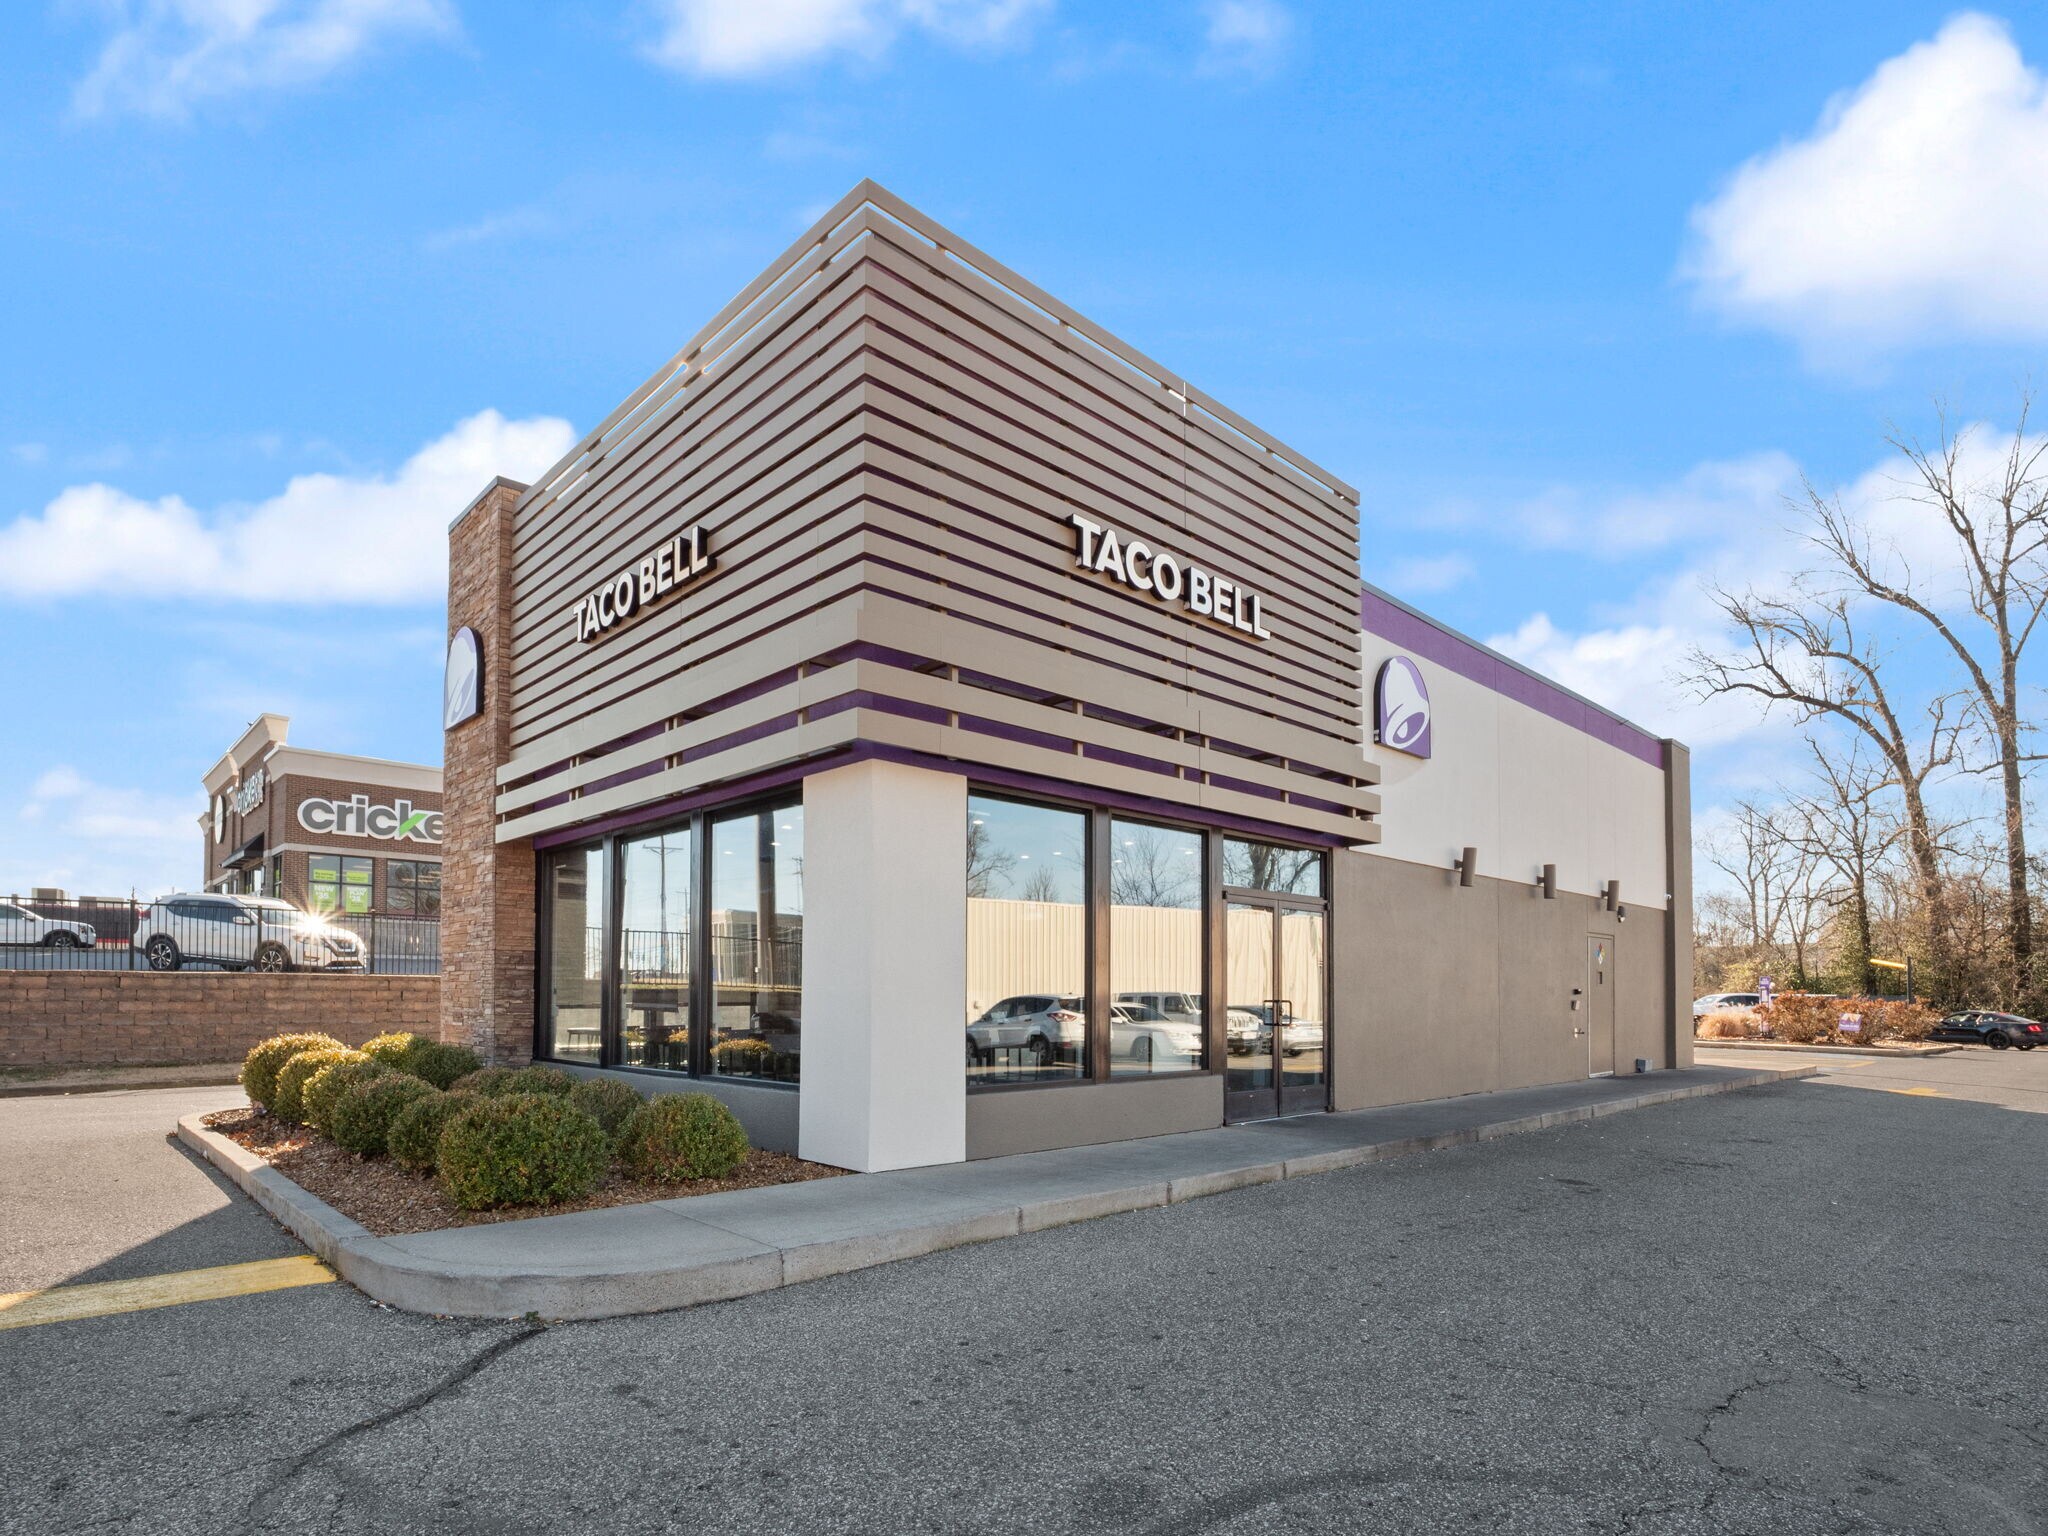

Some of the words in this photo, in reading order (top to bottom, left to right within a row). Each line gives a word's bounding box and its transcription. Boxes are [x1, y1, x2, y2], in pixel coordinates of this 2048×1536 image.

[573, 571, 635, 644] TACO
[639, 526, 709, 605] BELL
[1073, 513, 1182, 601] TACO
[1189, 566, 1272, 642] BELL
[300, 796, 443, 841] cricke
